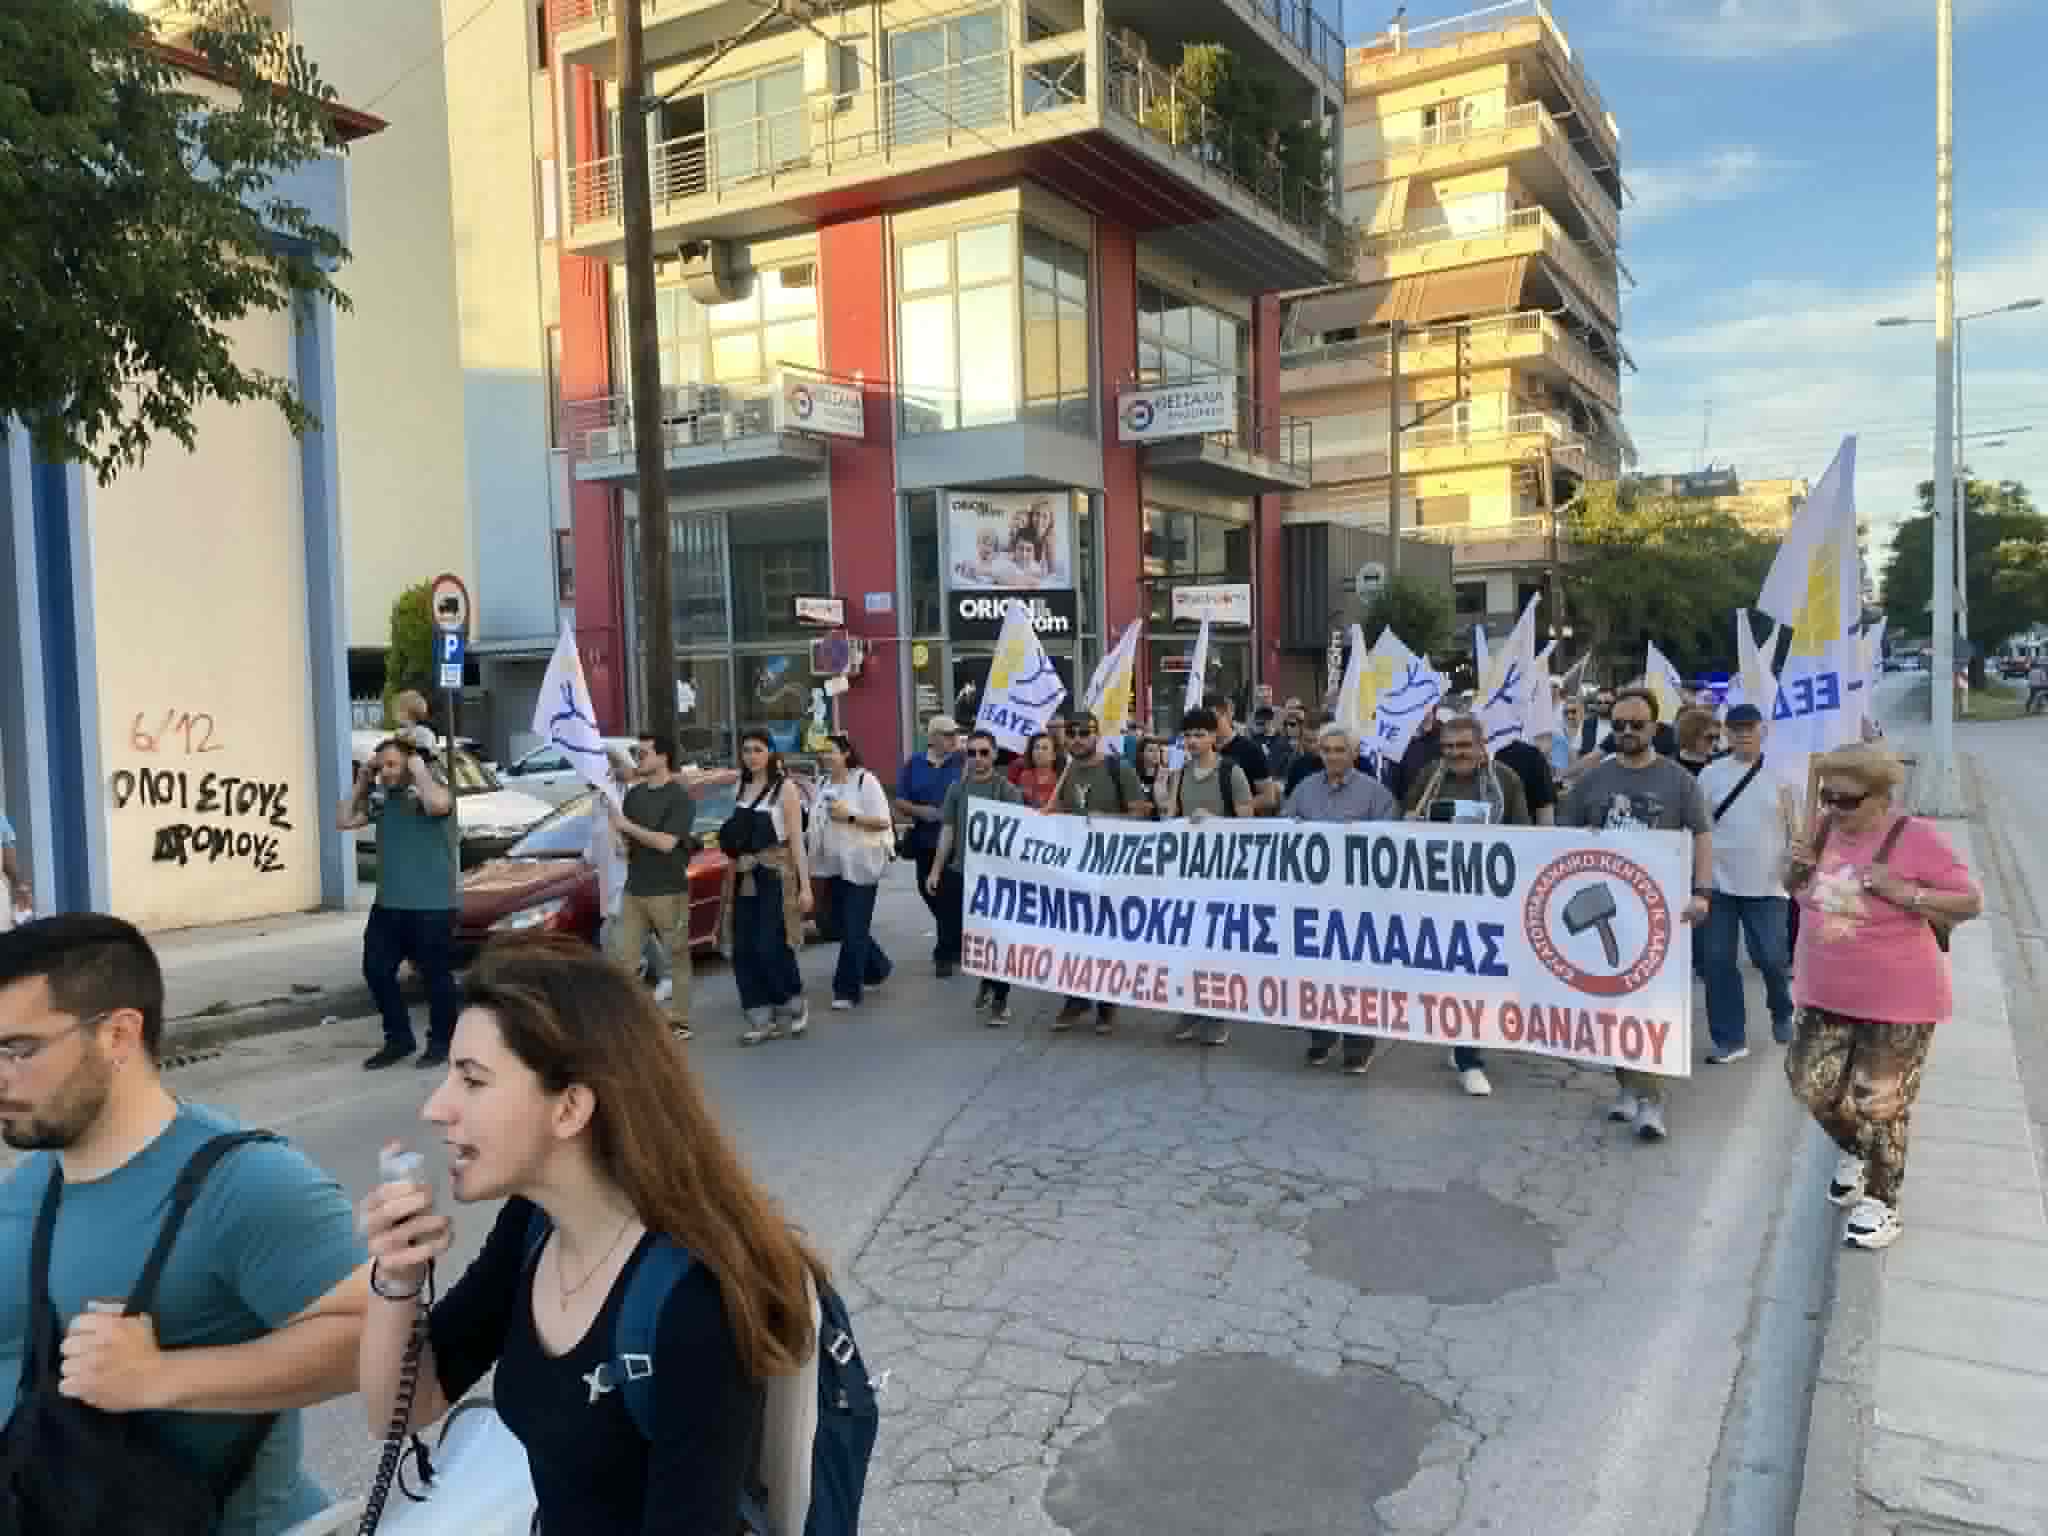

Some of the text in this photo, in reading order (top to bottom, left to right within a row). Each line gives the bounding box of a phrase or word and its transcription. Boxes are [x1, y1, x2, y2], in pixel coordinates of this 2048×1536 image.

[445, 633, 459, 660] P
[131, 707, 225, 755] 6/12
[968, 810, 1516, 898] ΟΧΙ ΣΤΟΝ ΙΜΠΕΡΙΑΛΙΣΤΙΚΟ ΠΟΛΕΜΟ
[969, 874, 1197, 945] ΑΠΕΜΠΛΟΚΗ
[1205, 900, 1279, 955] ΤΗΣ
[1293, 907, 1509, 977] ΕΛΛΑΔΑΣ
[962, 932, 998, 972] ΕΞΩ
[1004, 943, 1054, 982] ΑΠΟ
[1193, 970, 1249, 1010] ΕΞΩ
[1258, 975, 1287, 1017] ΟΙ
[1299, 977, 1409, 1032] ΒΑΣΕΙΣ
[1418, 992, 1485, 1039] ΤΟΥ
[1499, 1000, 1672, 1065] ΘΑΝΑΤΟΥ
